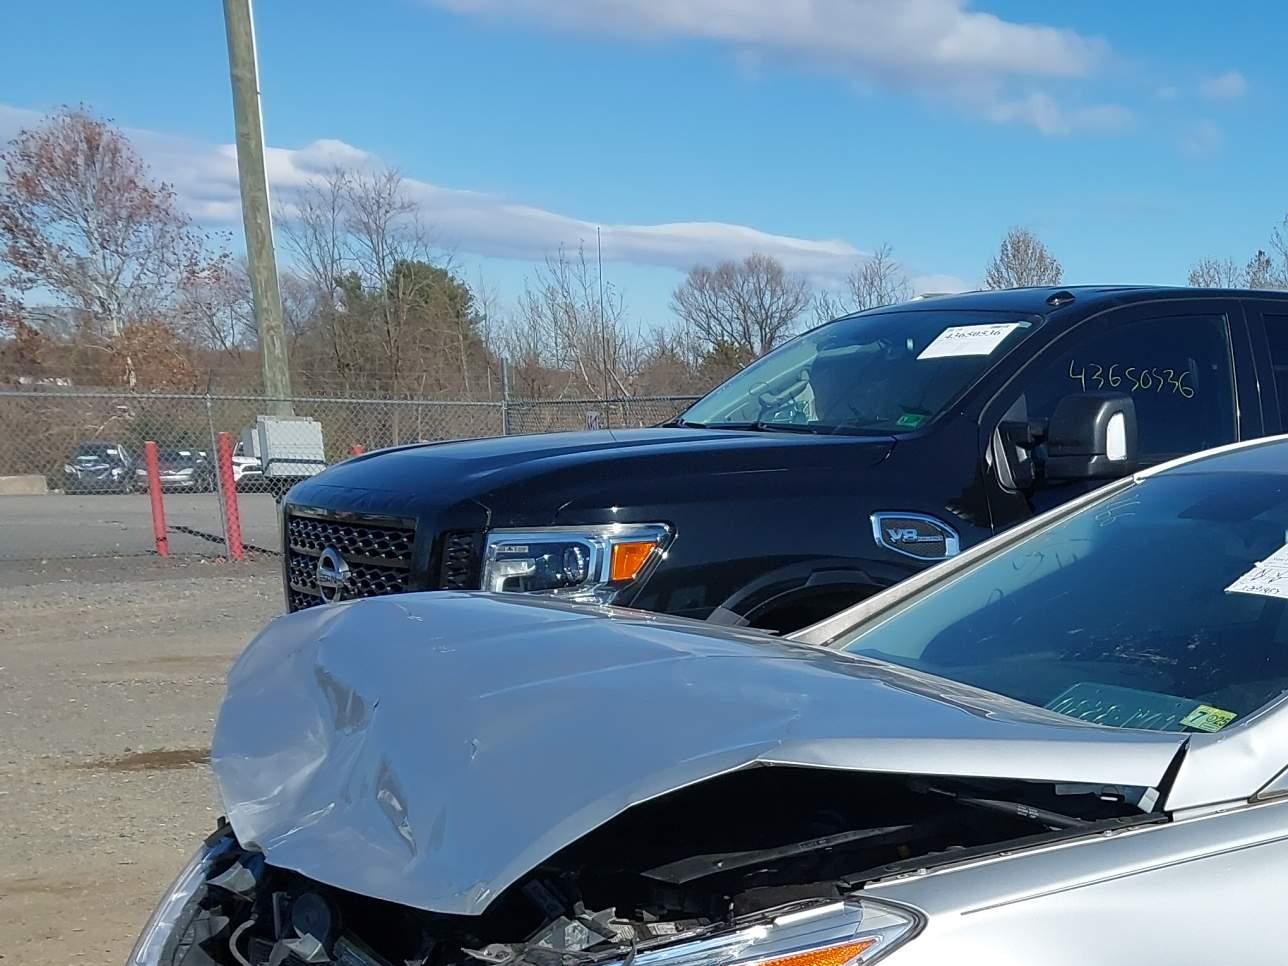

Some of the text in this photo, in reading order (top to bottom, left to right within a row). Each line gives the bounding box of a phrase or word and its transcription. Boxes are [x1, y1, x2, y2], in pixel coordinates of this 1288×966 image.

[1069, 359, 1195, 399] 43650536
[885, 527, 918, 543] V8
[1190, 710, 1208, 723] 7
